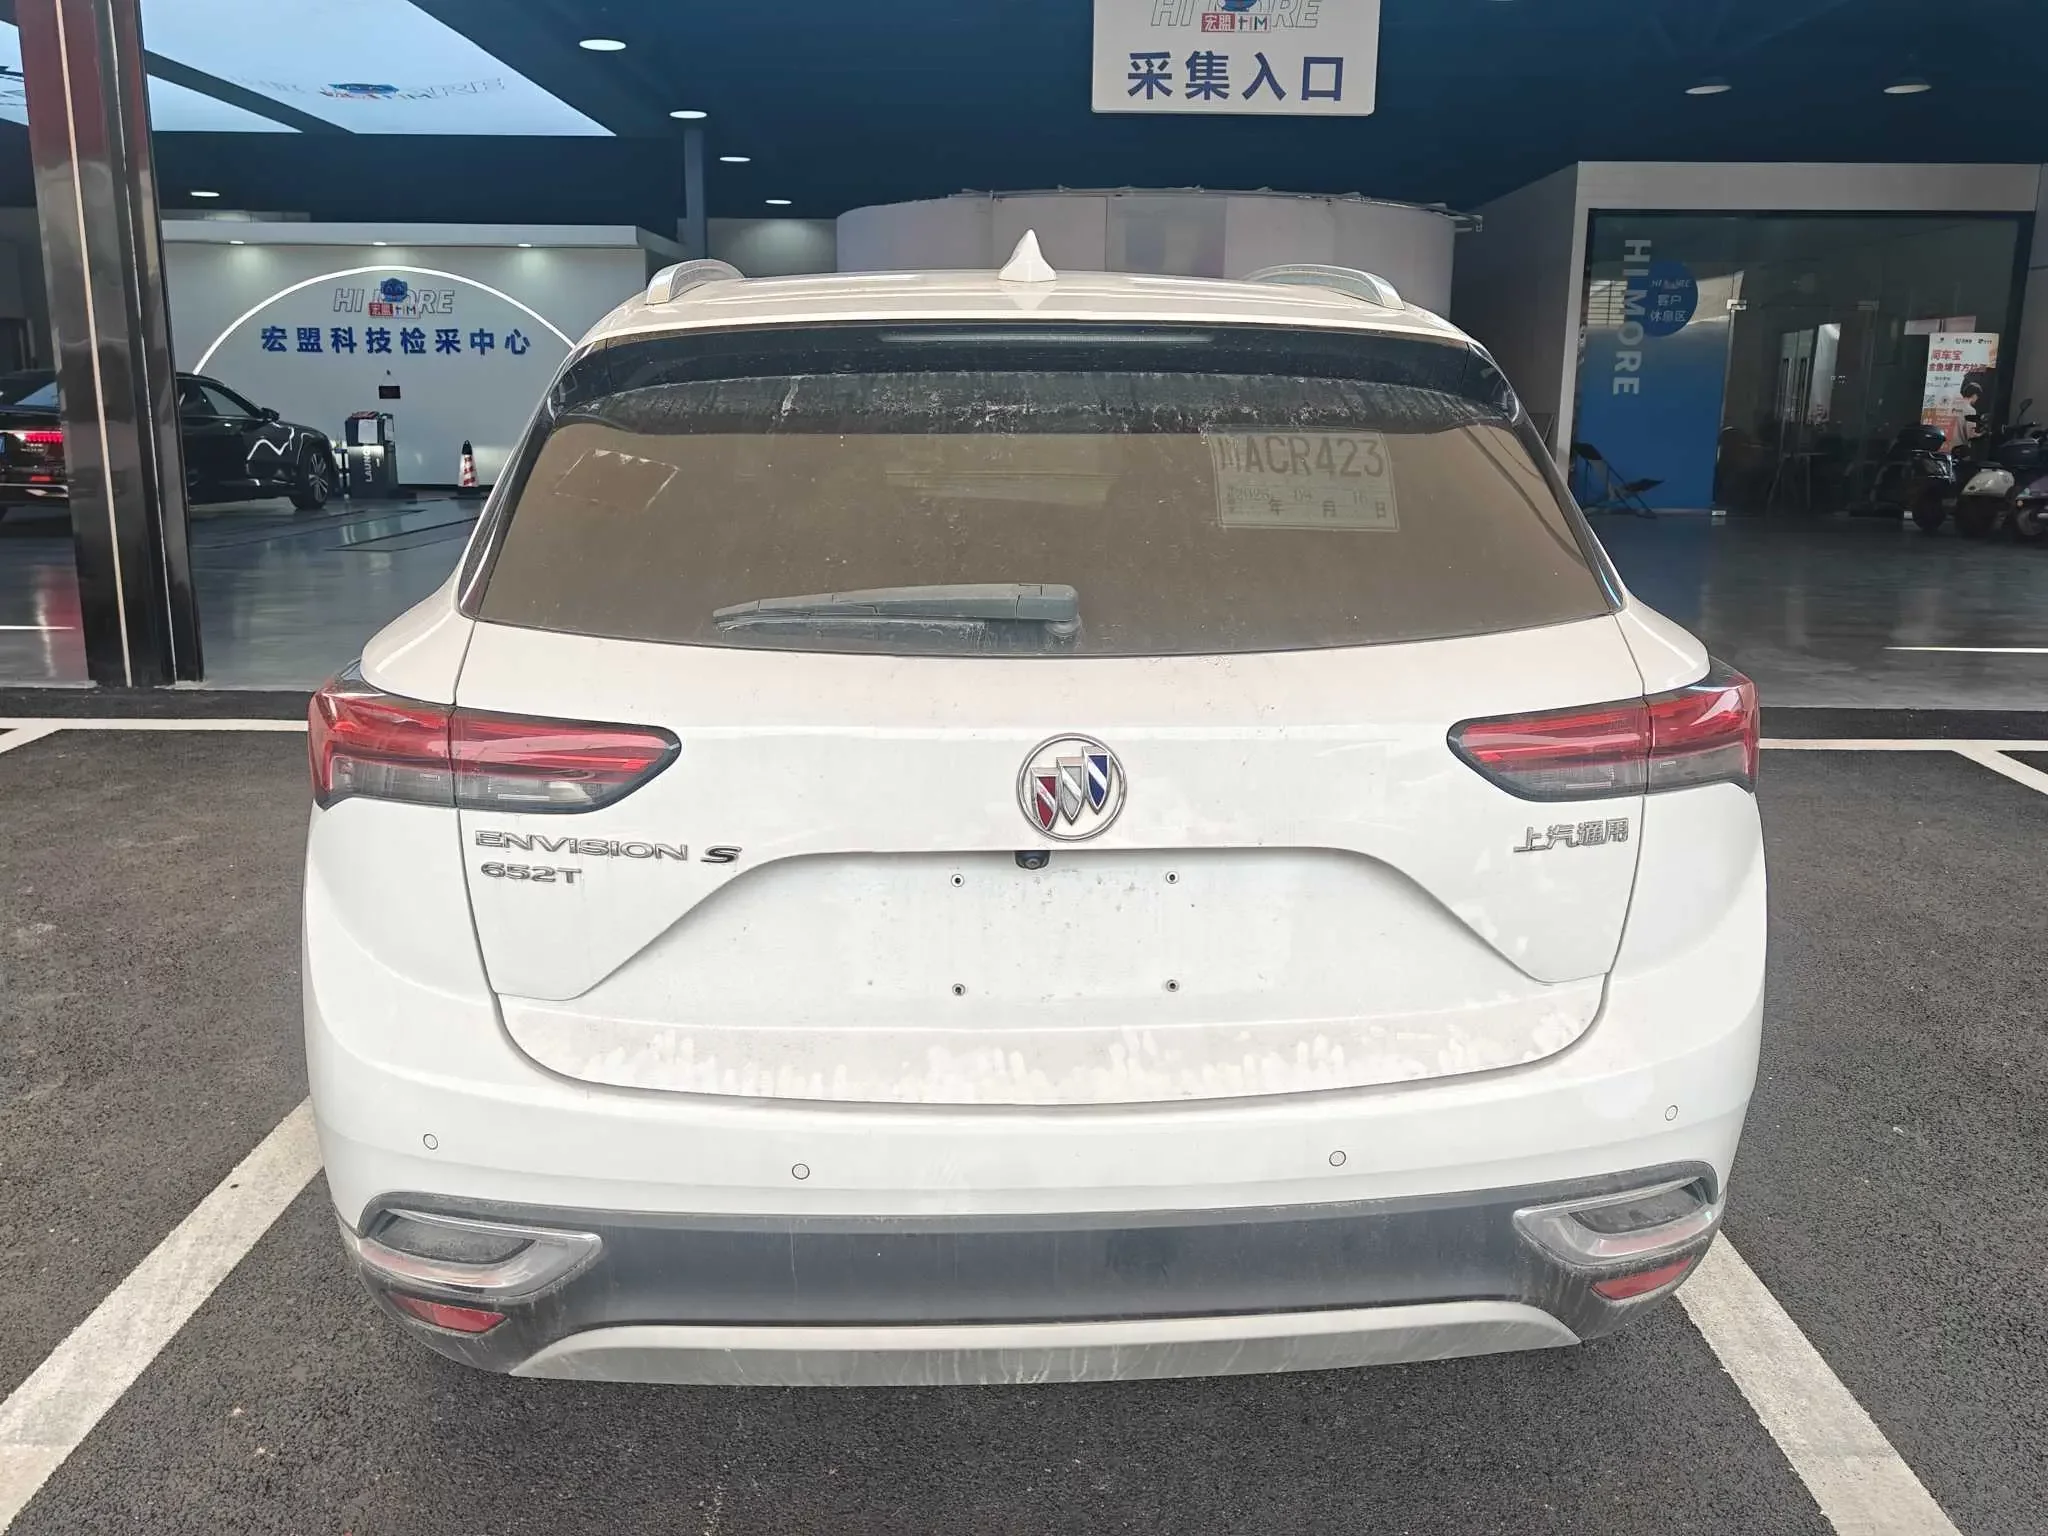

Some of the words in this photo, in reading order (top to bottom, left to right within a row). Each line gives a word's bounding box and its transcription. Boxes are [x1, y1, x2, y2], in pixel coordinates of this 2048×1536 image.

[1203, 14, 1234, 31] 宏盟
[1127, 51, 1344, 101] 采集入口
[333, 288, 364, 312] HI
[261, 325, 531, 355] 宏盟科技检采中心
[475, 829, 689, 861] ENVISION
[700, 844, 743, 864] S
[1513, 818, 1629, 853] 上汽通用
[480, 860, 582, 884] 652T
